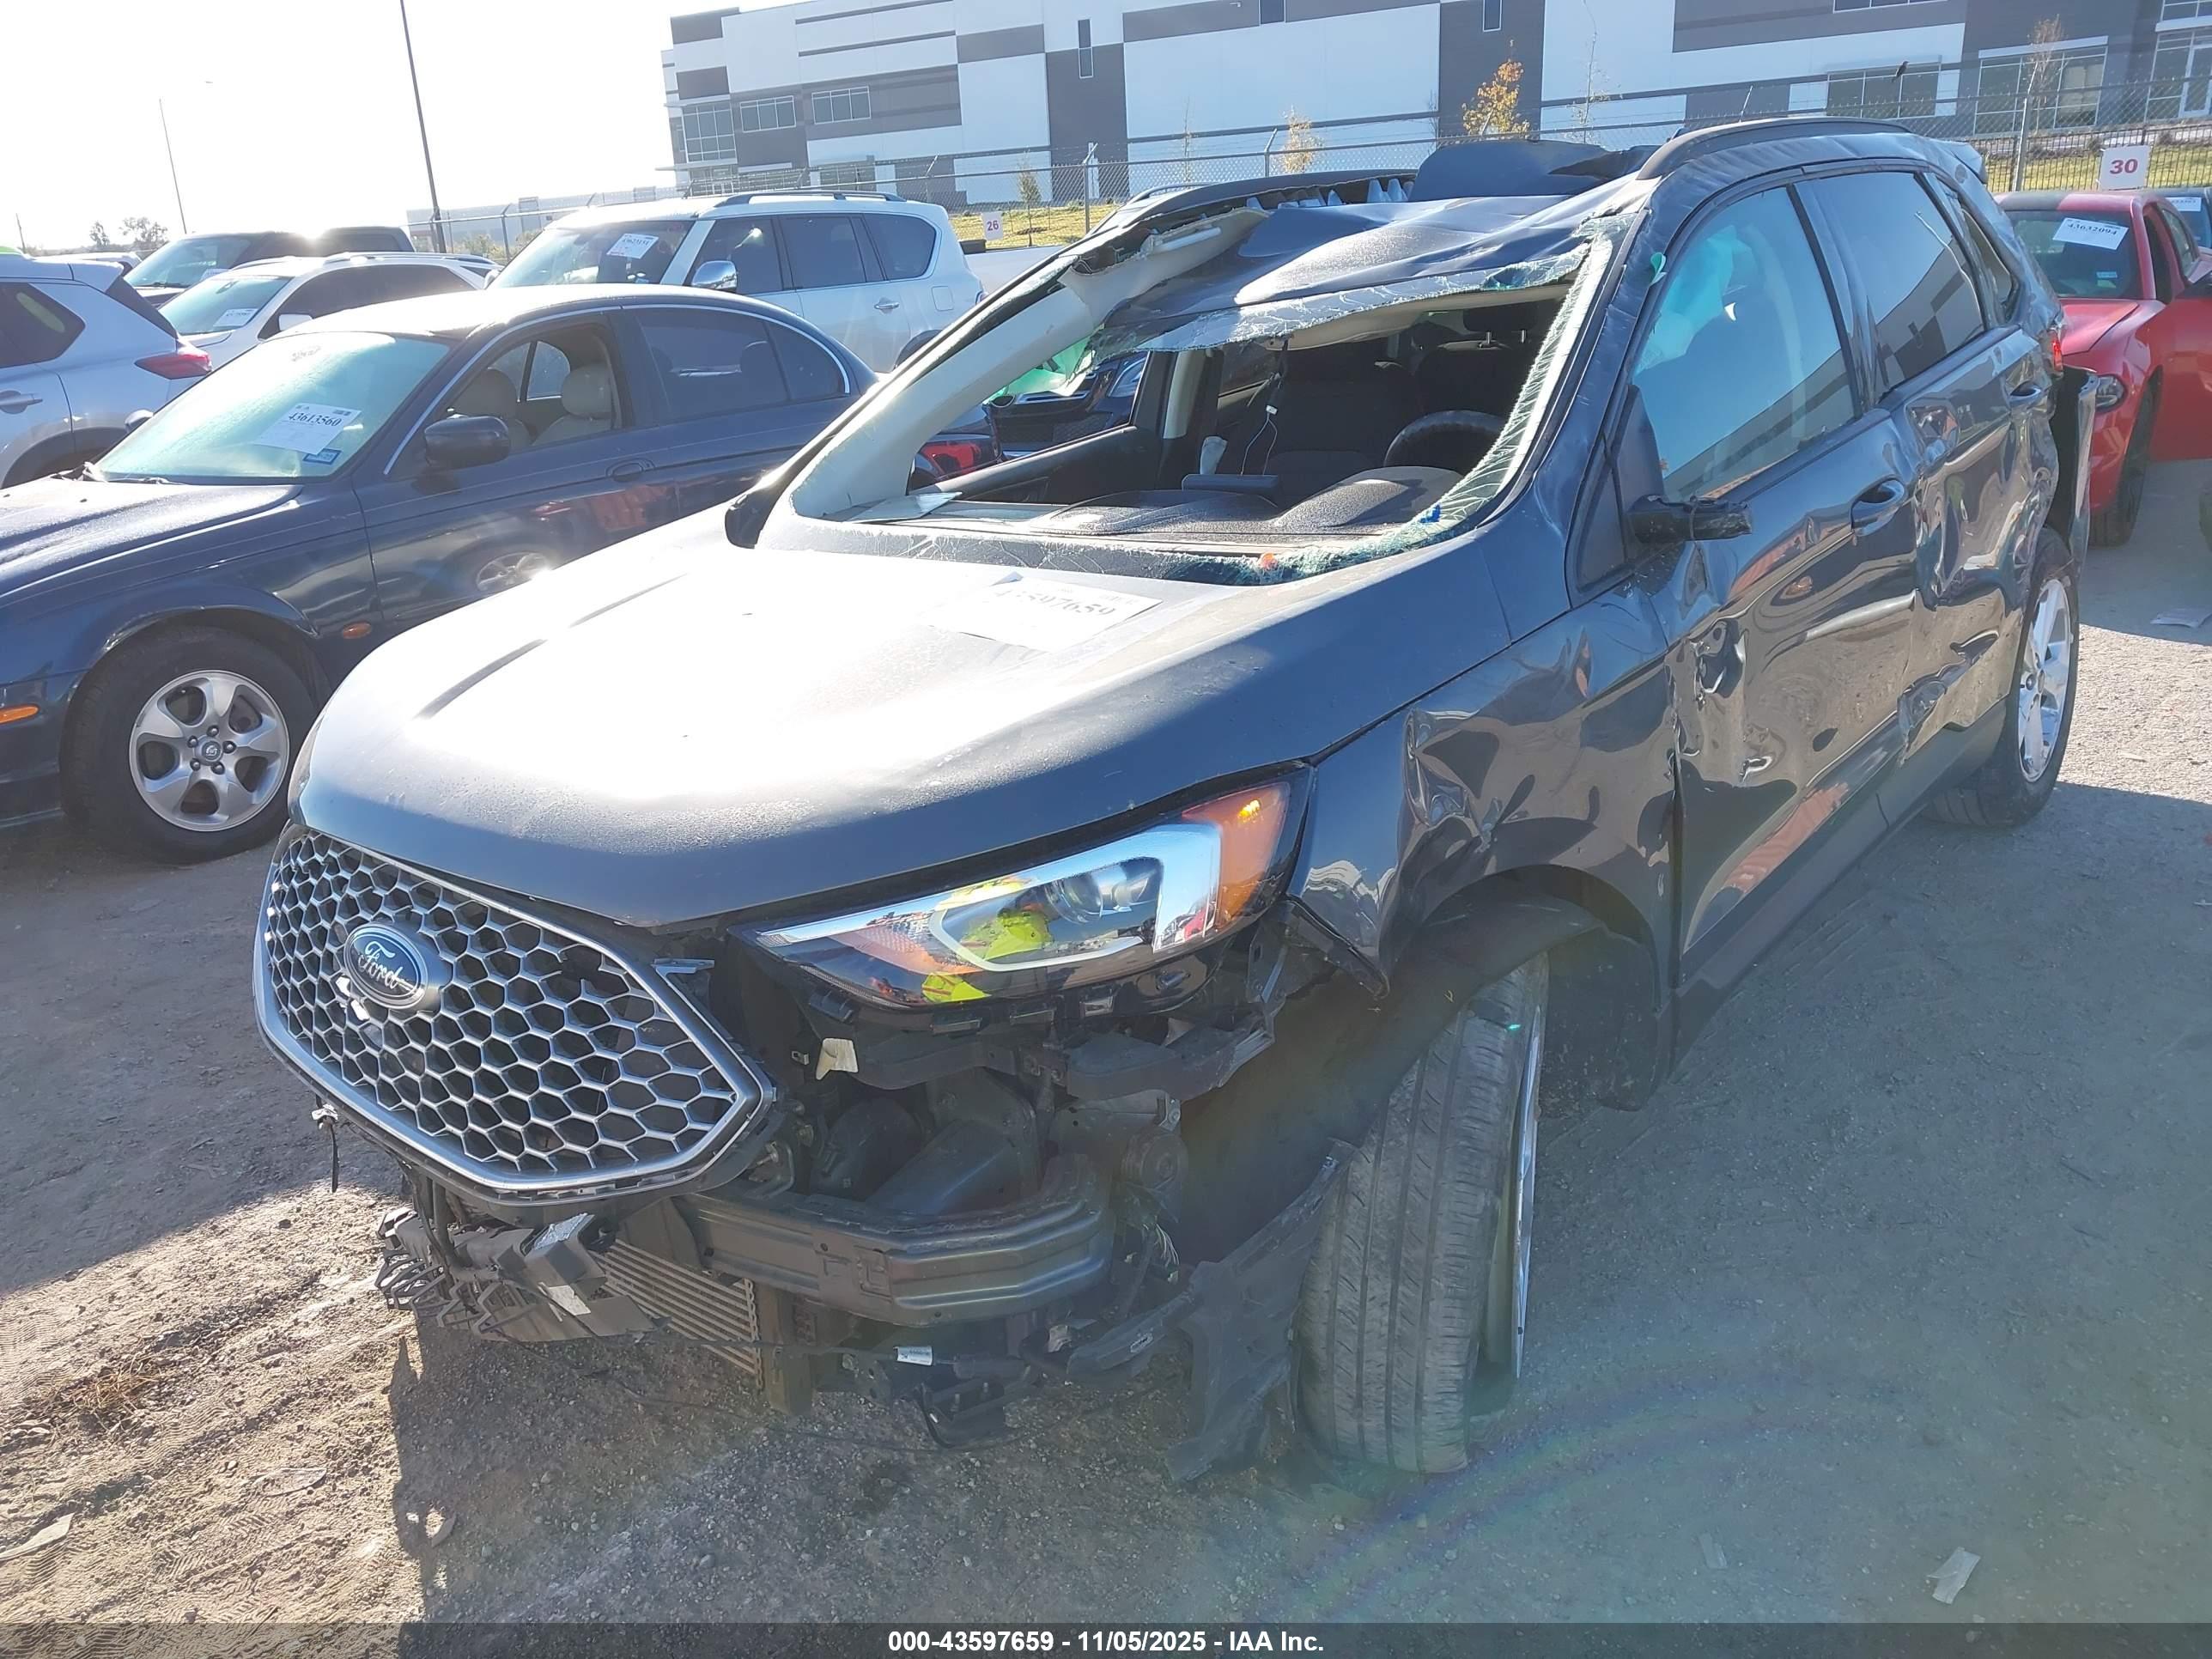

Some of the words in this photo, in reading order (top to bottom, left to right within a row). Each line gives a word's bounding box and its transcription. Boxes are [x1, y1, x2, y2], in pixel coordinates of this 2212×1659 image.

[2109, 158, 2138, 174] 30
[987, 220, 1000, 231] 26
[289, 412, 342, 427] 43613560
[357, 940, 415, 990] Ford
